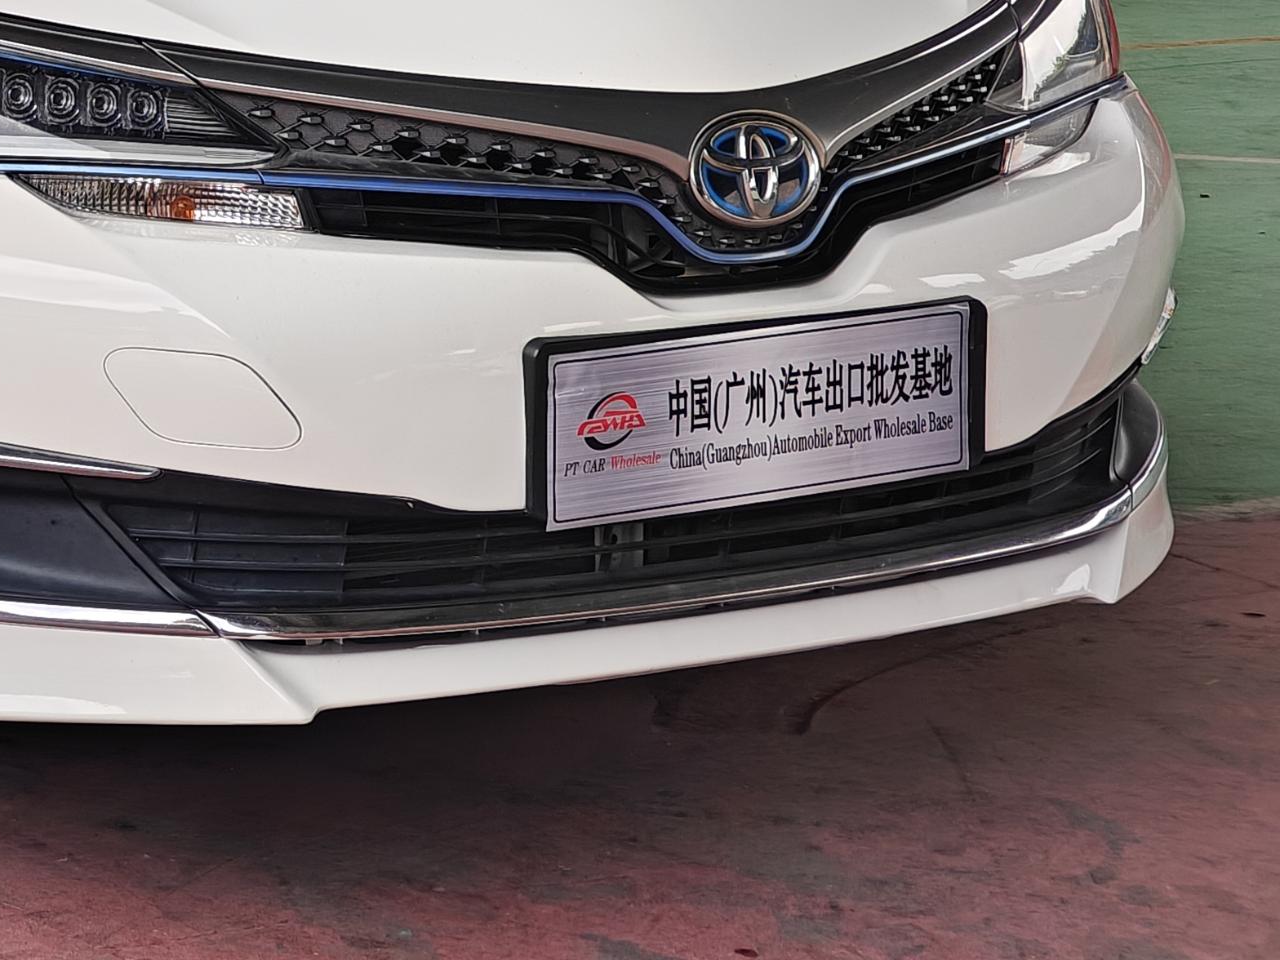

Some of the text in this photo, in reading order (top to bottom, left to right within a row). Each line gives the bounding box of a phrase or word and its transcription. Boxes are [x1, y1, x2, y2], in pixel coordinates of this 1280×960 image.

[835, 422, 872, 451] Export
[873, 413, 927, 441] Wholesale
[927, 411, 954, 432] Base
[563, 450, 662, 477] PT CAR Wholesale
